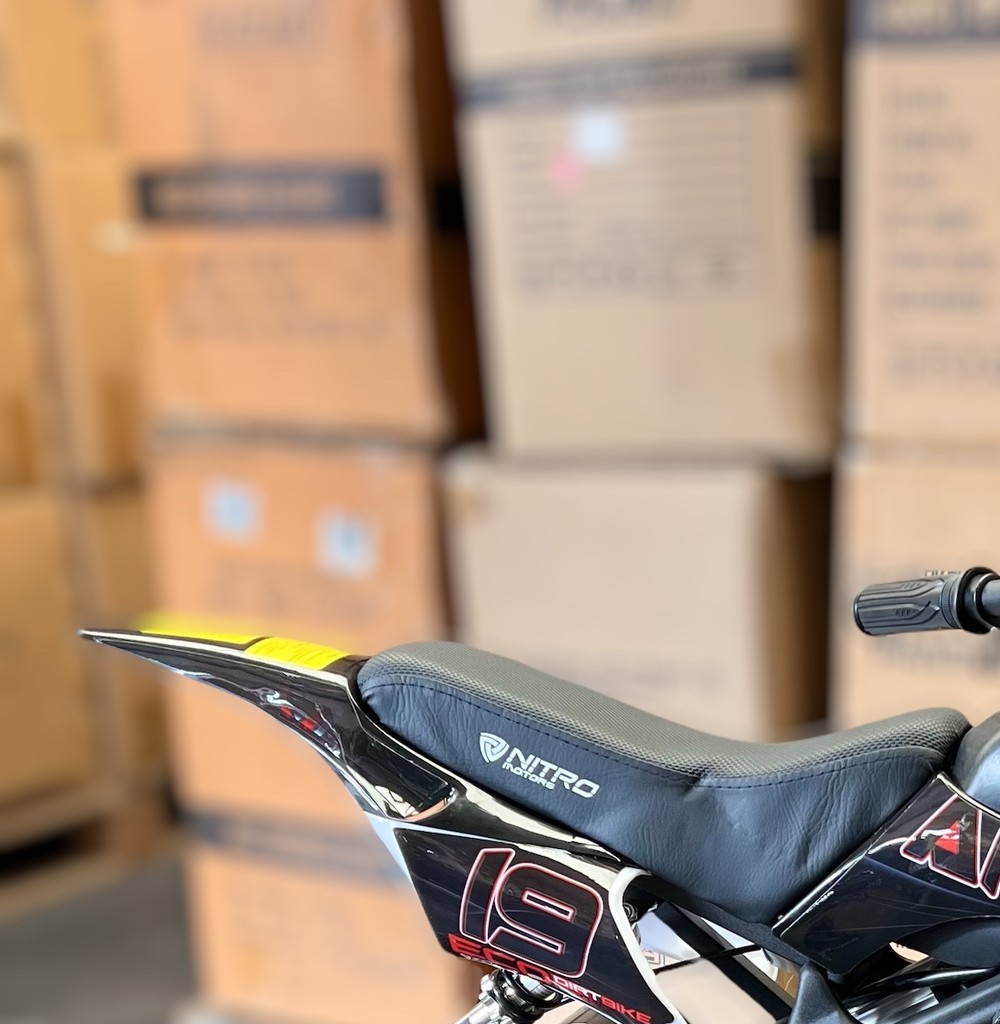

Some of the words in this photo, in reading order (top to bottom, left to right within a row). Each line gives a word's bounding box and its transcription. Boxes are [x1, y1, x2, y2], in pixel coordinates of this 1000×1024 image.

[501, 761, 556, 790] MOTORS
[504, 747, 600, 798] NITRO
[459, 847, 604, 979] 19
